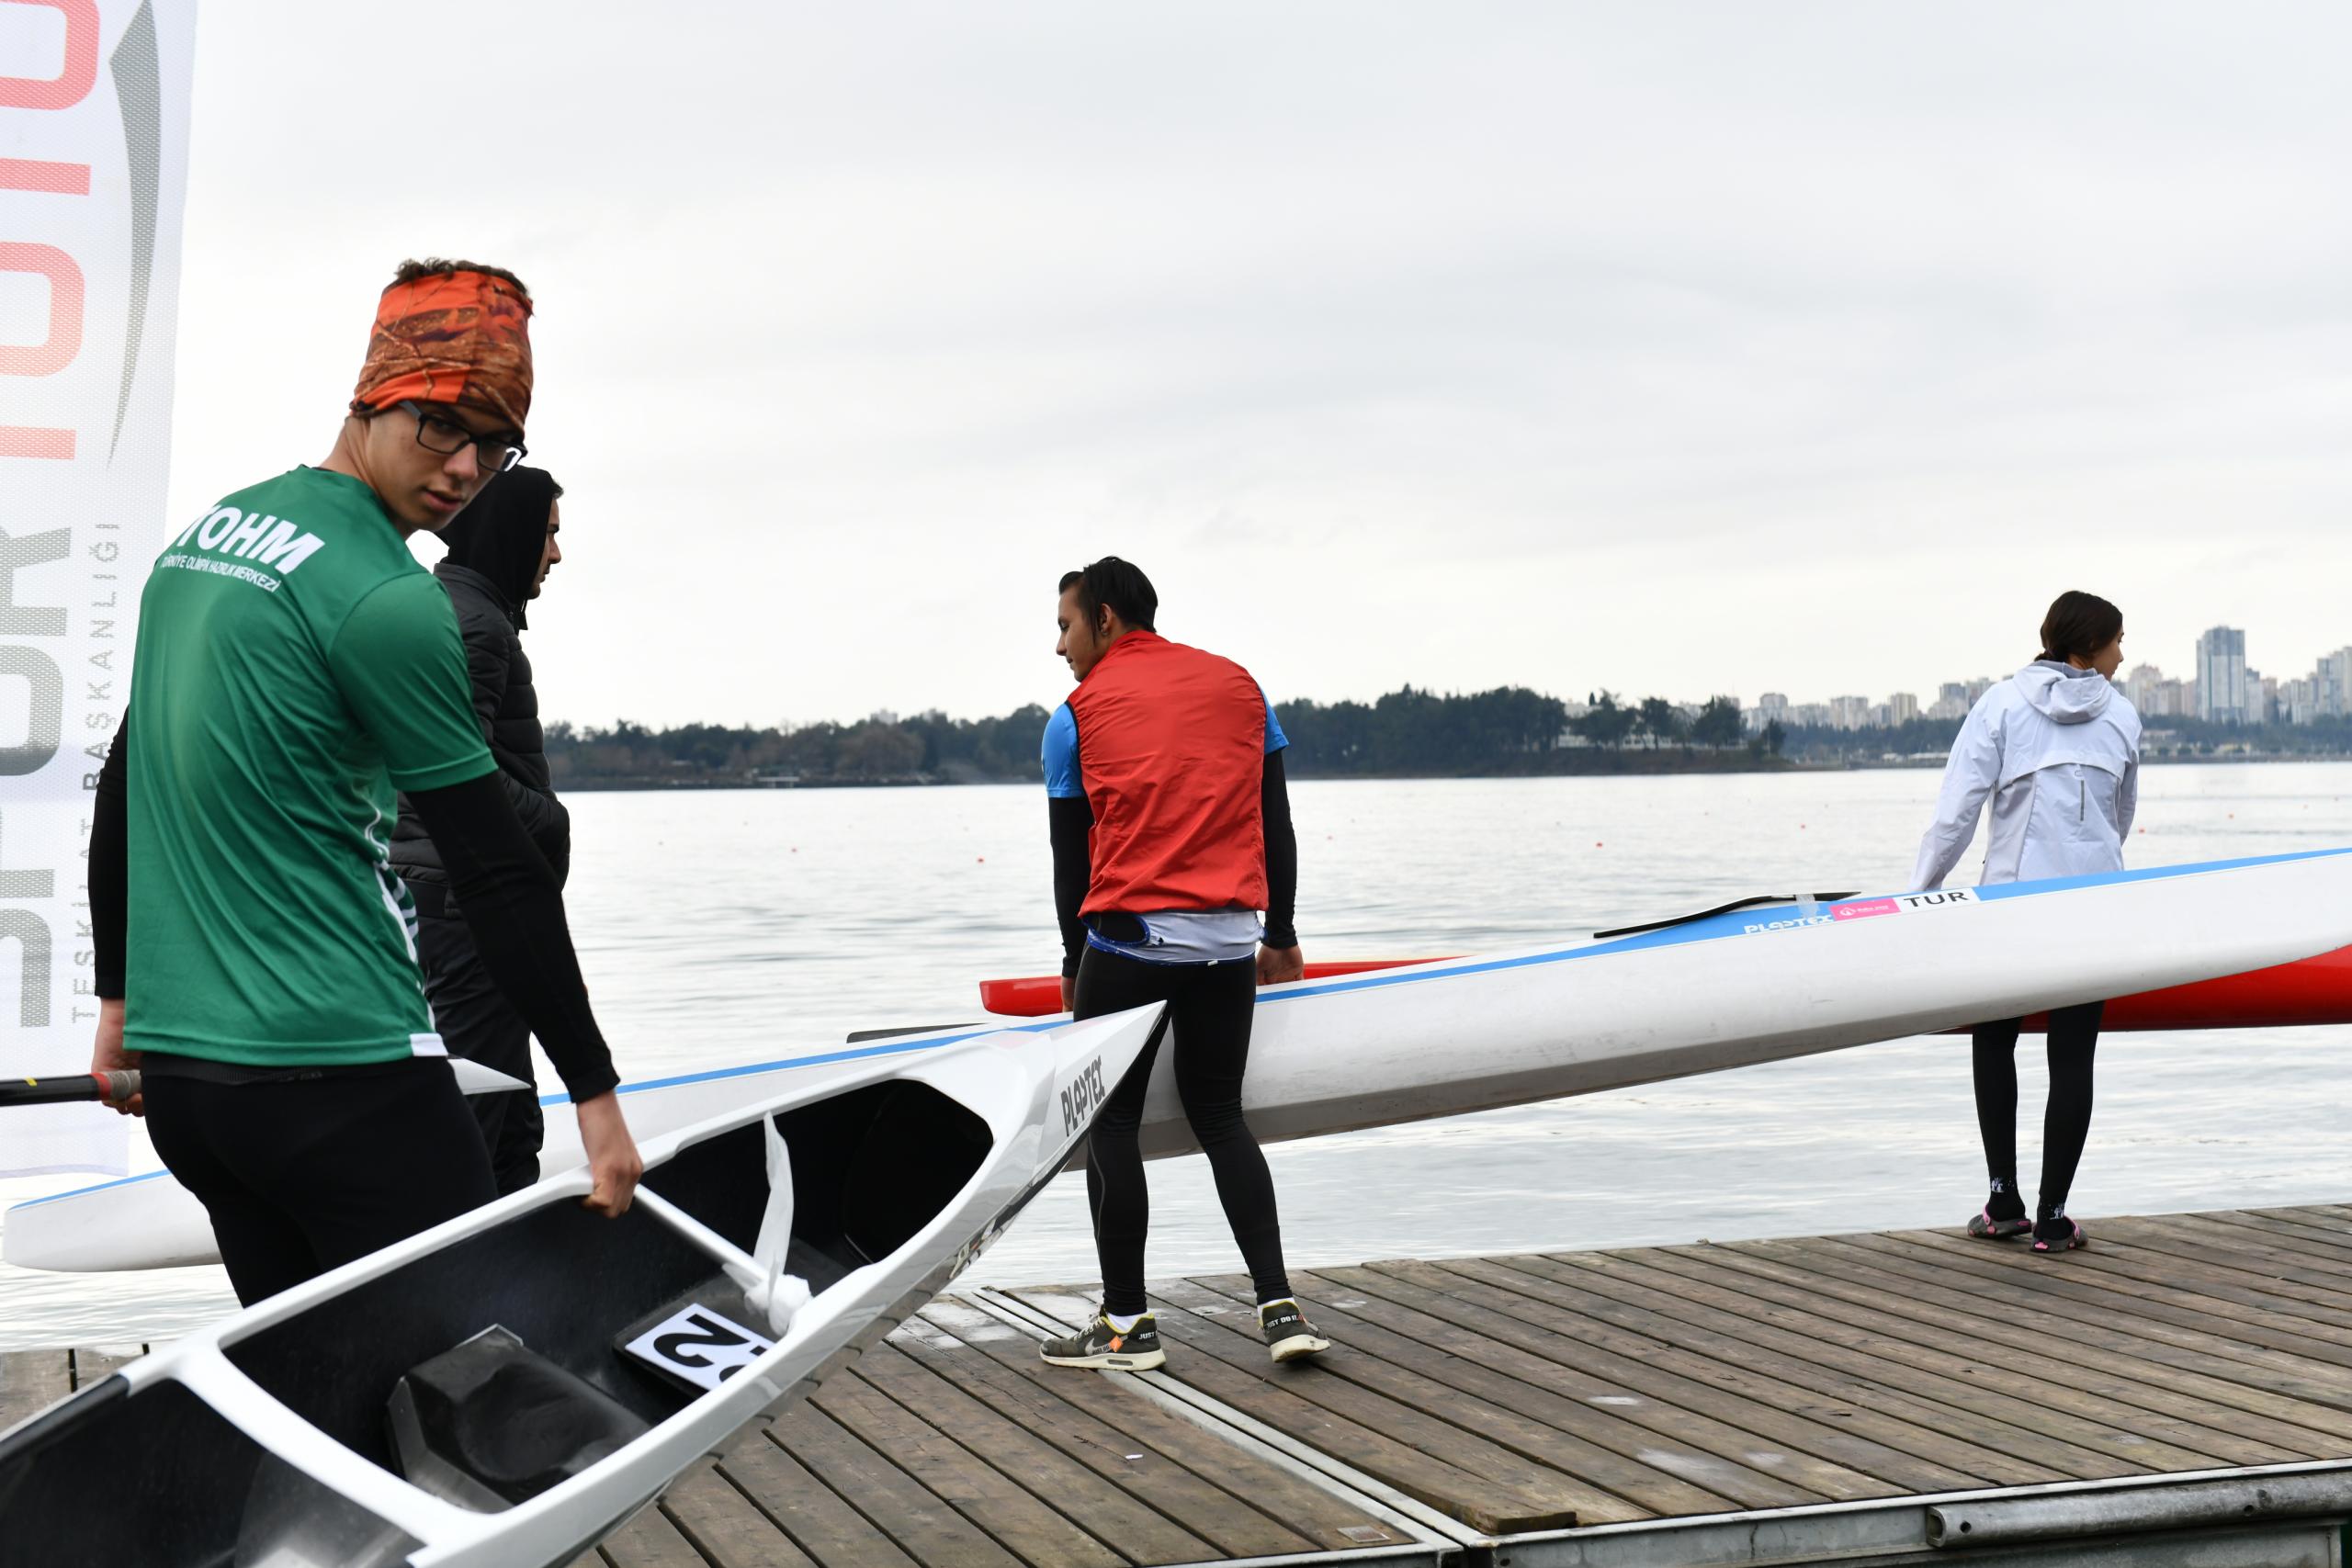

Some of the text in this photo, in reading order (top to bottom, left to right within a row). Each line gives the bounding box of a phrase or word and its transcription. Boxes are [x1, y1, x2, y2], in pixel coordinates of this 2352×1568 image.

[232, 564, 281, 592] MERKEZİ
[83, 523, 120, 791] BAŞKANLIĞI
[1904, 891, 1969, 908] TUR
[1280, 1315, 1291, 1324] DO
[1138, 1331, 1155, 1340] JUST
